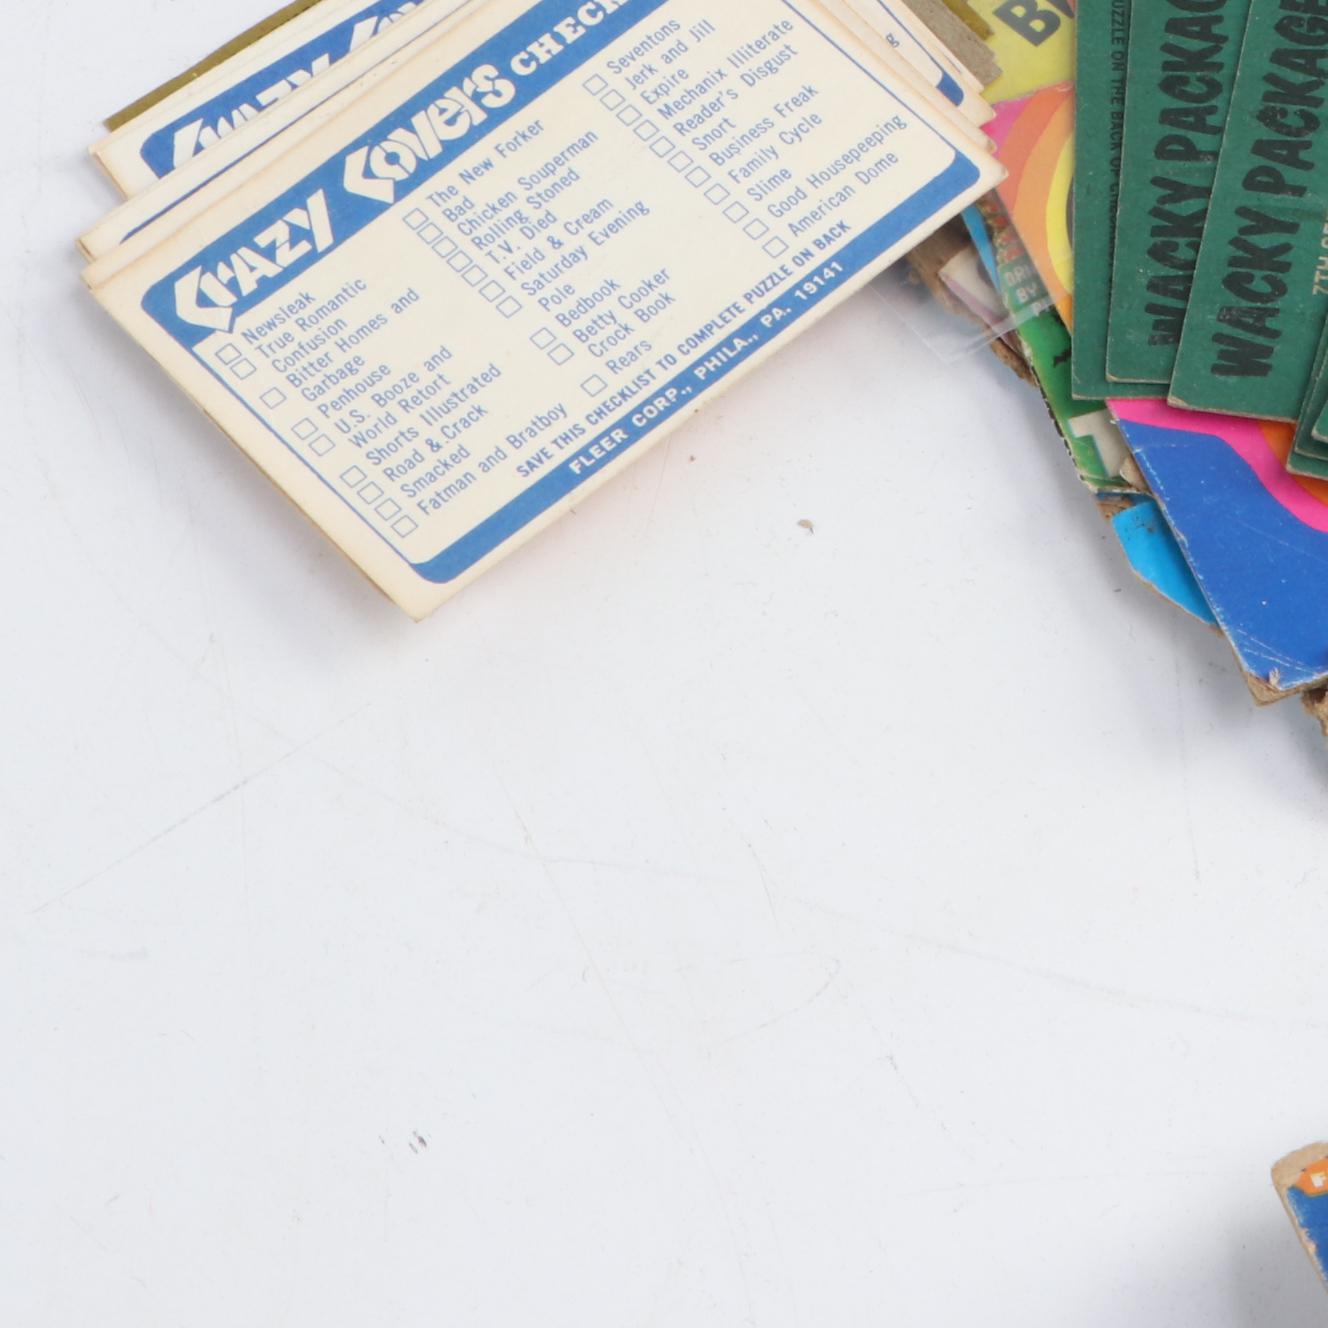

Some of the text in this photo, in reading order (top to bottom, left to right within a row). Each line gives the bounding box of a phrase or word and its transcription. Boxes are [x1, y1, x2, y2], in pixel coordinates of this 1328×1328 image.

[606, 19, 681, 75] Seventons
[624, 19, 716, 91] Jerk and Jill
[639, 69, 690, 105] Expire
[656, 20, 794, 120] Mechanix Illiterate
[426, 119, 544, 208] The New Forker
[708, 85, 819, 167] Business Freak
[767, 115, 908, 218] Good Housepeeping
[456, 131, 599, 237] Chicken Souperman
[240, 292, 316, 345] Newsleak
[254, 279, 367, 359] True Romantic
[1210, 207, 1304, 377] WACKY
[516, 220, 851, 478] SAVE THIS CHECKLIST TO COMPLETE PUZZLE ON BACK
[568, 261, 843, 474] FLEER CORP., PHILA., PA. 19141
[365, 363, 502, 466] Shorts Illustrated
